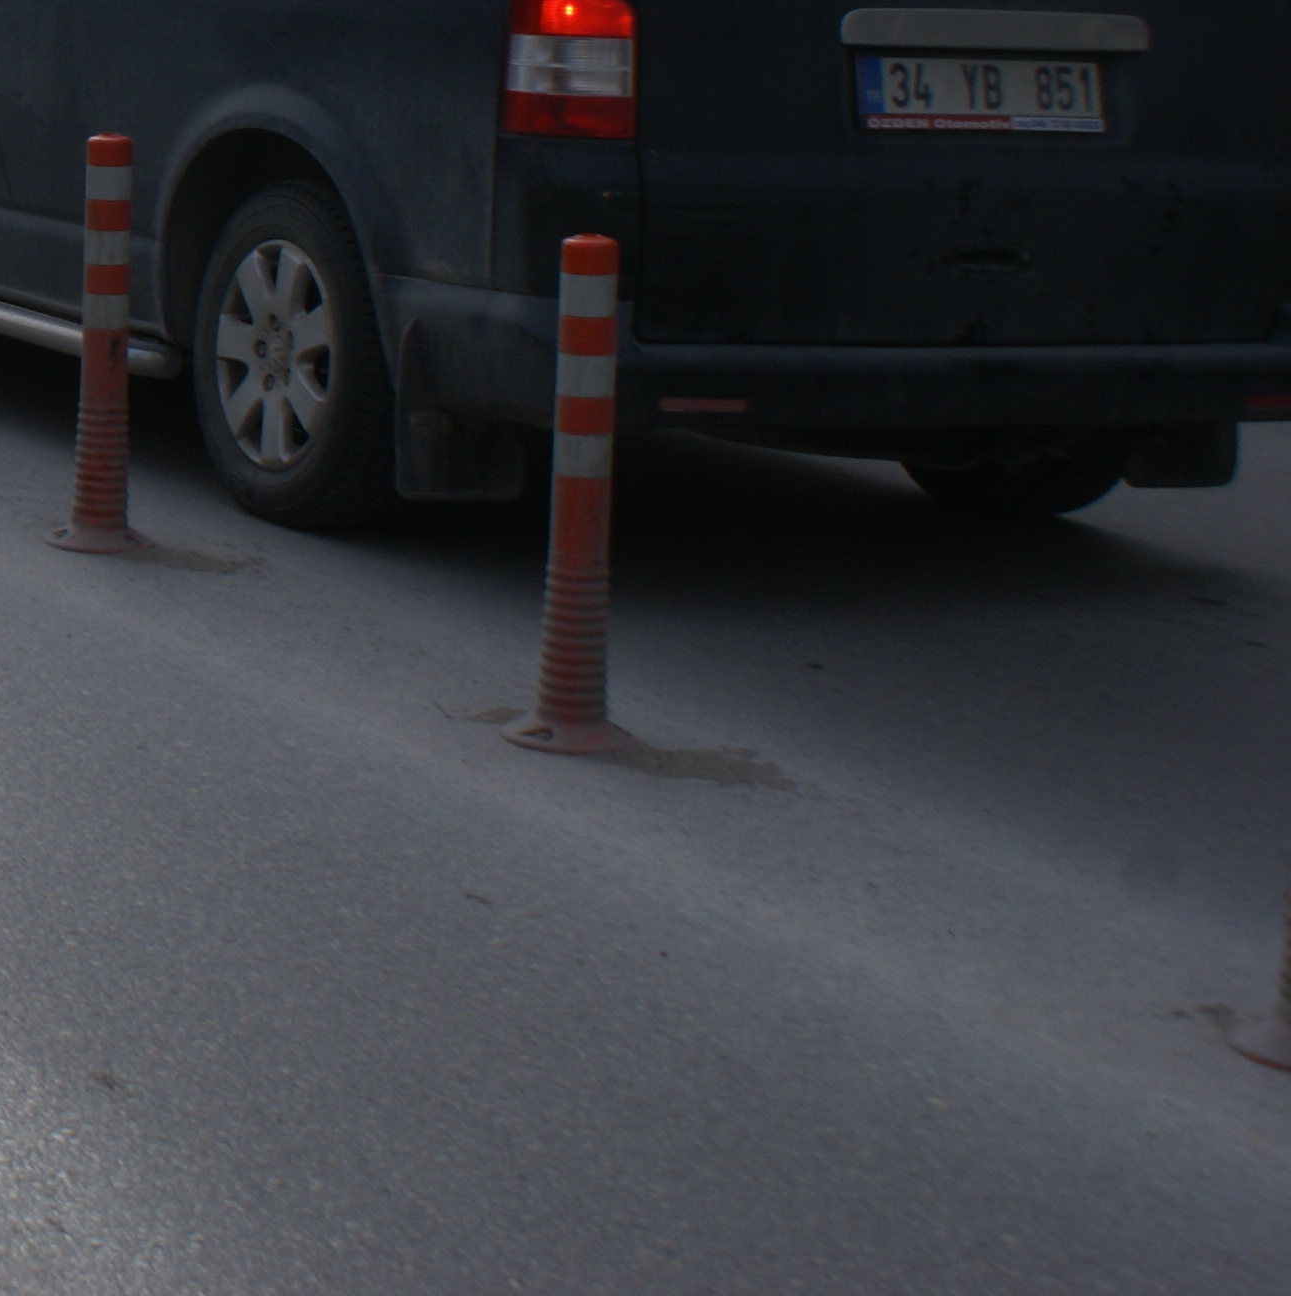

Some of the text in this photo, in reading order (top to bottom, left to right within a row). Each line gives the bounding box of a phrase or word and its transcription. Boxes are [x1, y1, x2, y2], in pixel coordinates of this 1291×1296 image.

[888, 62, 1094, 113] 34 YB 851
